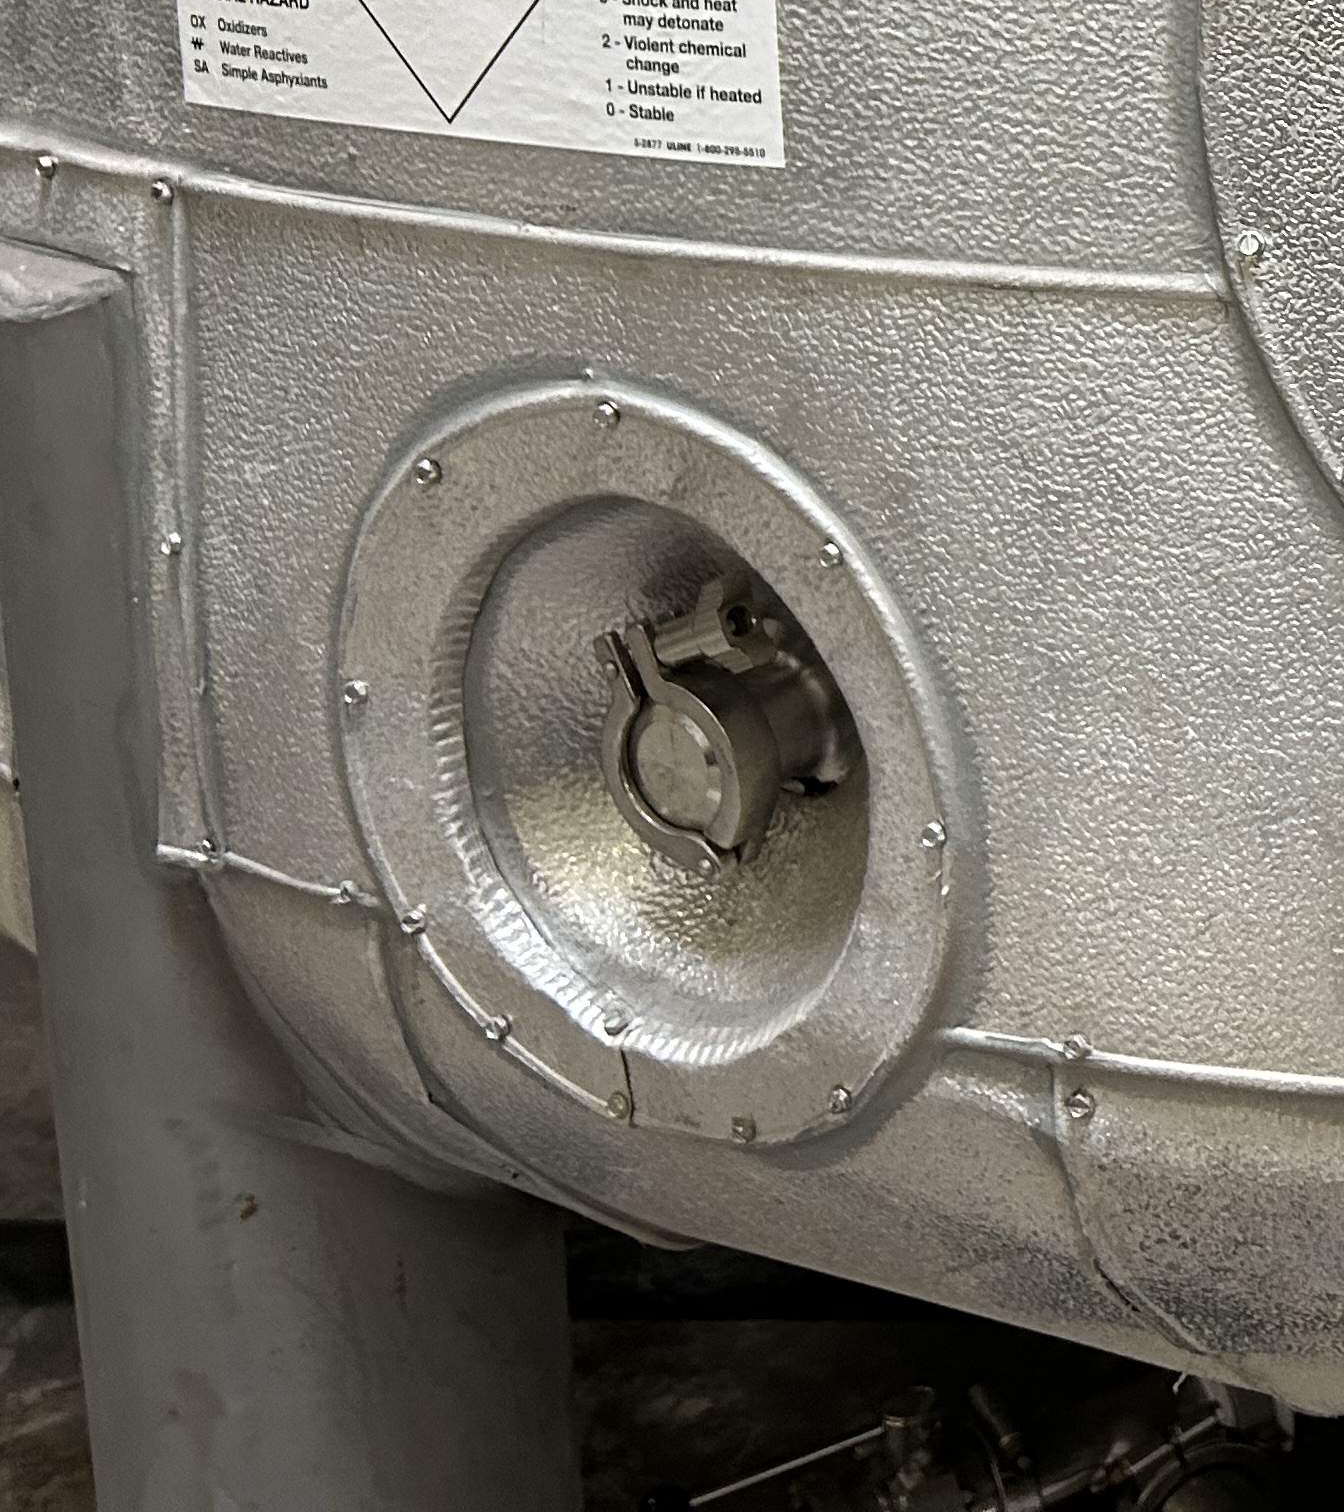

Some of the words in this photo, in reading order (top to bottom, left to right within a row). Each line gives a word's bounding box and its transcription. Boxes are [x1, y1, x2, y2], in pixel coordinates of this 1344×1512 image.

[190, 14, 206, 30] OX
[217, 17, 268, 38] Oxidizers
[623, 14, 653, 31] may
[657, 13, 724, 32] detonate
[219, 40, 251, 57] Water
[253, 44, 308, 65] Reactives
[602, 33, 611, 49] 2
[624, 35, 675, 54] Violent
[679, 40, 746, 58] chemical
[194, 59, 210, 74] SA
[221, 62, 258, 82] Simple
[261, 68, 328, 89] Asphyxiants
[626, 56, 679, 76] change
[606, 78, 612, 93] 1
[627, 79, 692, 99] Unstable
[696, 85, 705, 100] if
[710, 86, 762, 104] heated
[606, 102, 615, 117] 0
[629, 104, 675, 122] Stable
